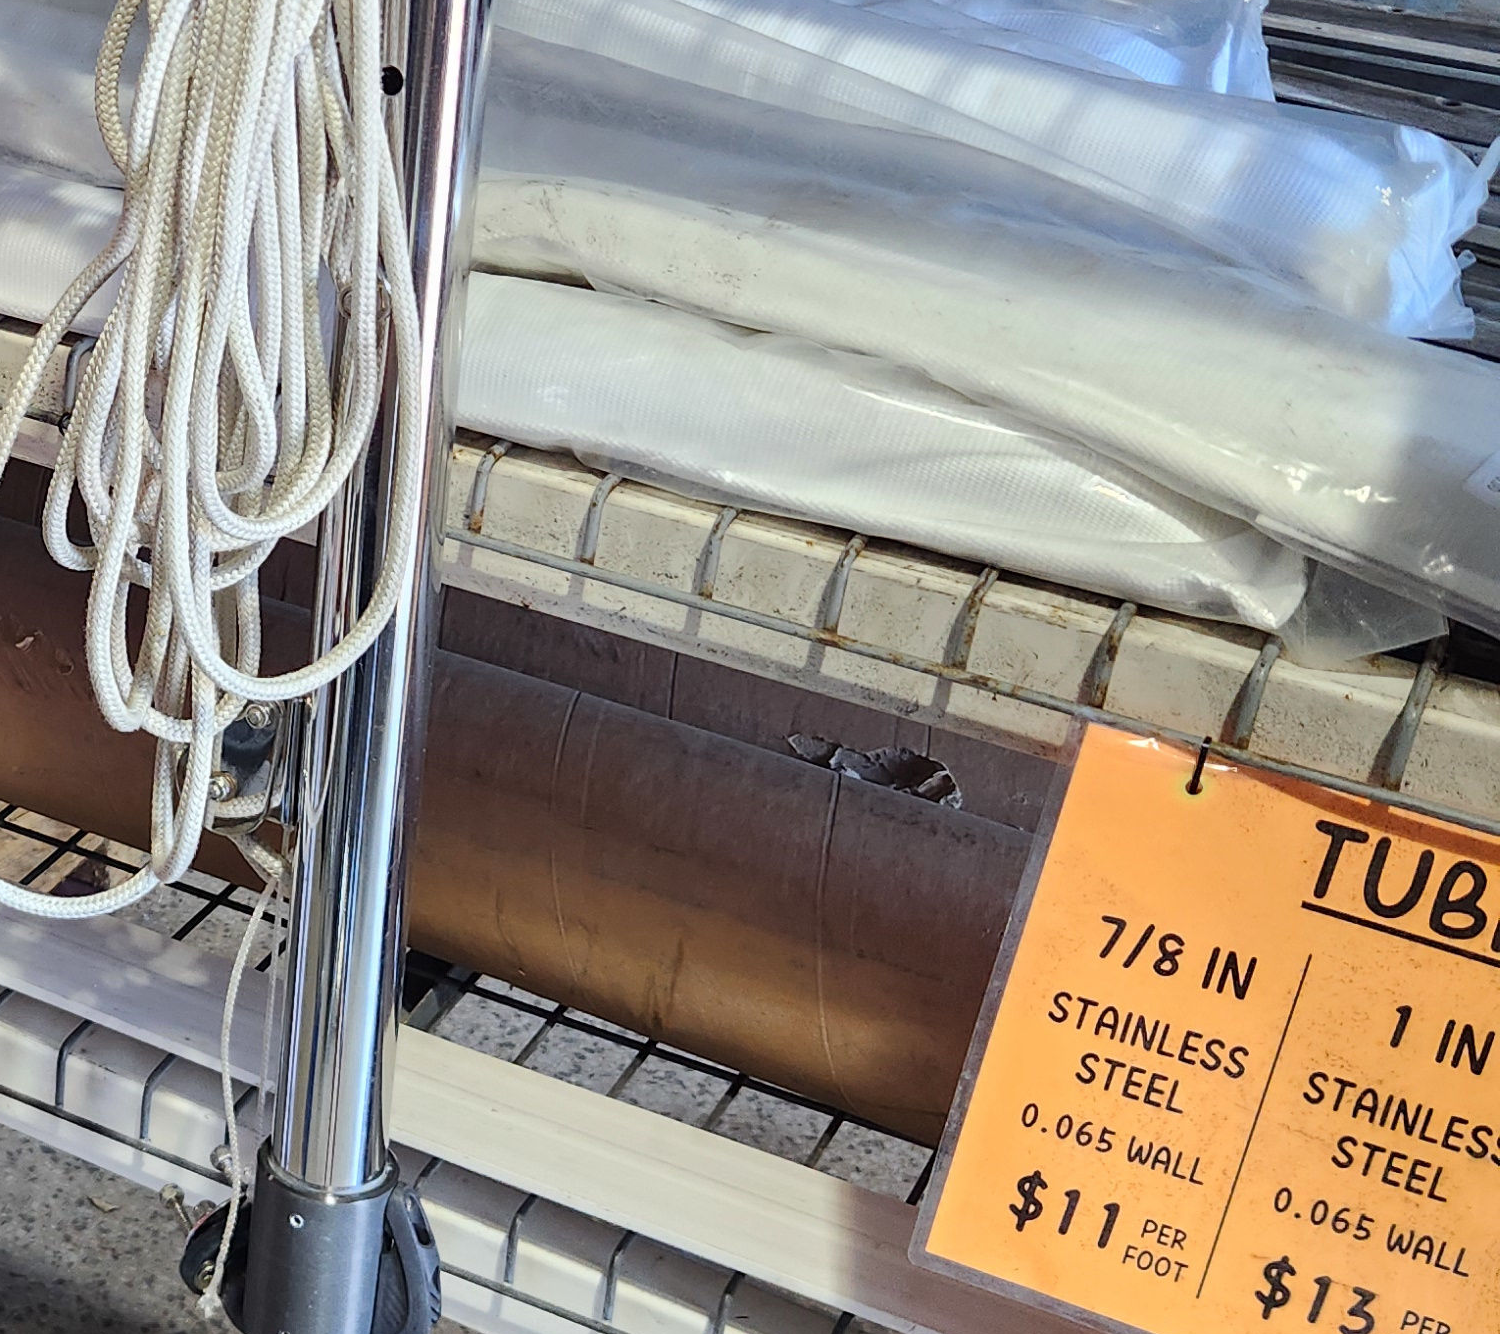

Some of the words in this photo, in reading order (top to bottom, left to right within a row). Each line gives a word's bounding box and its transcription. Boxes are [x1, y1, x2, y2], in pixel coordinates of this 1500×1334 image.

[1315, 820, 1500, 954] TUB
[1100, 916, 1184, 976] 7/8
[1202, 947, 1257, 999] IN
[1048, 992, 1249, 1078] STAINLESS
[1389, 1005, 1412, 1048] 1
[1436, 1020, 1495, 1075] IN
[1076, 1053, 1182, 1113] STEEL
[1022, 1104, 1115, 1153] 0.065
[1128, 1137, 1203, 1185] WALL
[1332, 1136, 1446, 1203] STEEL
[1009, 1171, 1119, 1249] $11
[1141, 1219, 1186, 1249] PER
[1274, 1188, 1374, 1241] 0.065
[1387, 1224, 1468, 1277] WALL
[1123, 1246, 1188, 1282] FOOT
